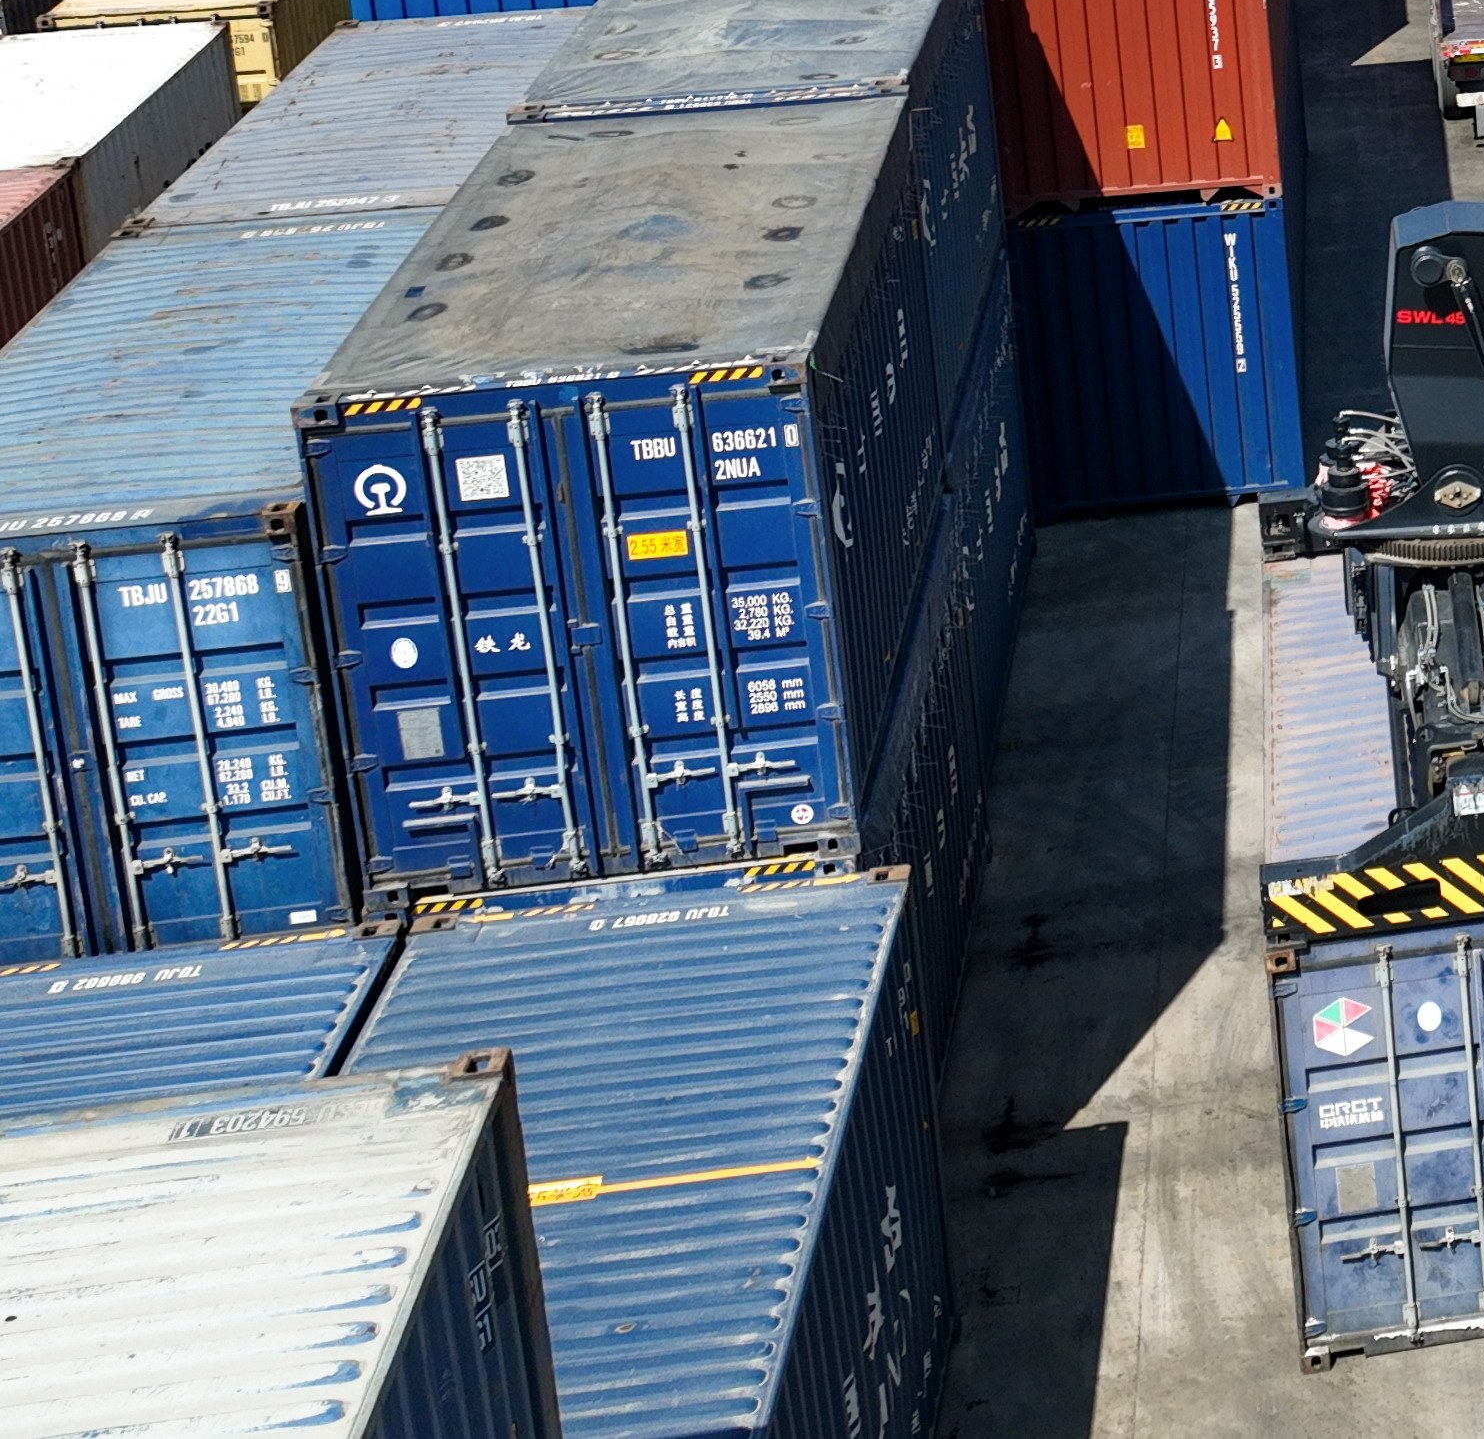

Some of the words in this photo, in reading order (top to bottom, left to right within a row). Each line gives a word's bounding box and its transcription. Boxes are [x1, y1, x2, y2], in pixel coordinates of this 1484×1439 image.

[1396, 310, 1444, 324] SWL
[631, 437, 676, 461] TBBU
[712, 430, 777, 453] 636621
[715, 458, 761, 480] 2NUA
[629, 537, 658, 557] 2.55
[660, 532, 686, 553] 米宽
[118, 582, 167, 608] TBJU
[188, 574, 260, 600] 257868
[731, 594, 767, 609] 35,000
[772, 592, 793, 604] KG.
[193, 603, 239, 627] 22G1
[738, 607, 768, 620] 2,780
[773, 604, 794, 616] KG.
[774, 615, 795, 627] KG.
[748, 629, 770, 641] 39.4
[113, 691, 137, 705] MAX
[152, 686, 184, 701] GROSS
[255, 676, 275, 689] KG.
[747, 679, 776, 693] 6058
[781, 677, 803, 689] mm
[749, 690, 777, 704] 2550
[783, 689, 804, 700] mm
[784, 700, 806, 711] mm
[117, 715, 142, 729] TARE
[259, 701, 279, 713] KG.
[268, 754, 287, 766] KG.
[1319, 1096, 1383, 1118] CRCT
